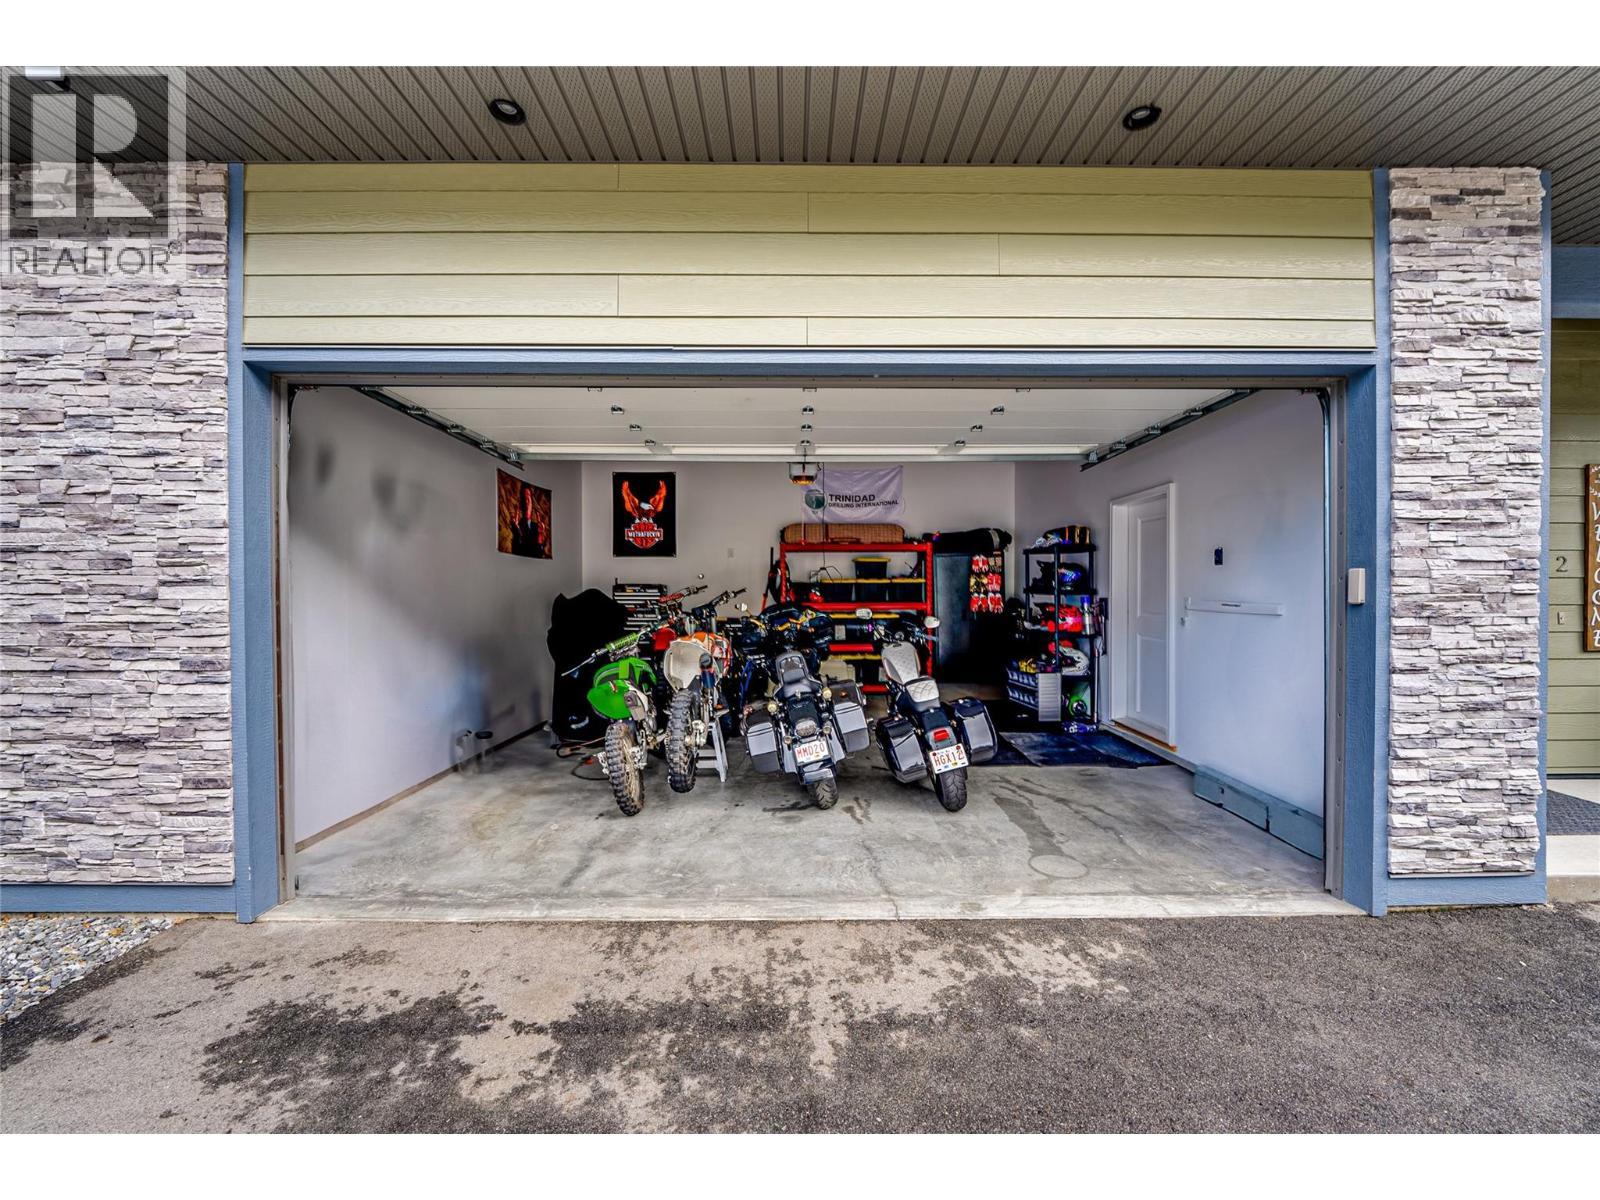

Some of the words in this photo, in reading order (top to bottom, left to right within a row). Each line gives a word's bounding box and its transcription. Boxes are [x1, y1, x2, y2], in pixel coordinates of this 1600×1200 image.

[828, 494, 876, 503] TRINIDAD
[855, 499, 899, 508] INTERNATIONAL
[1555, 555, 1568, 573] 2
